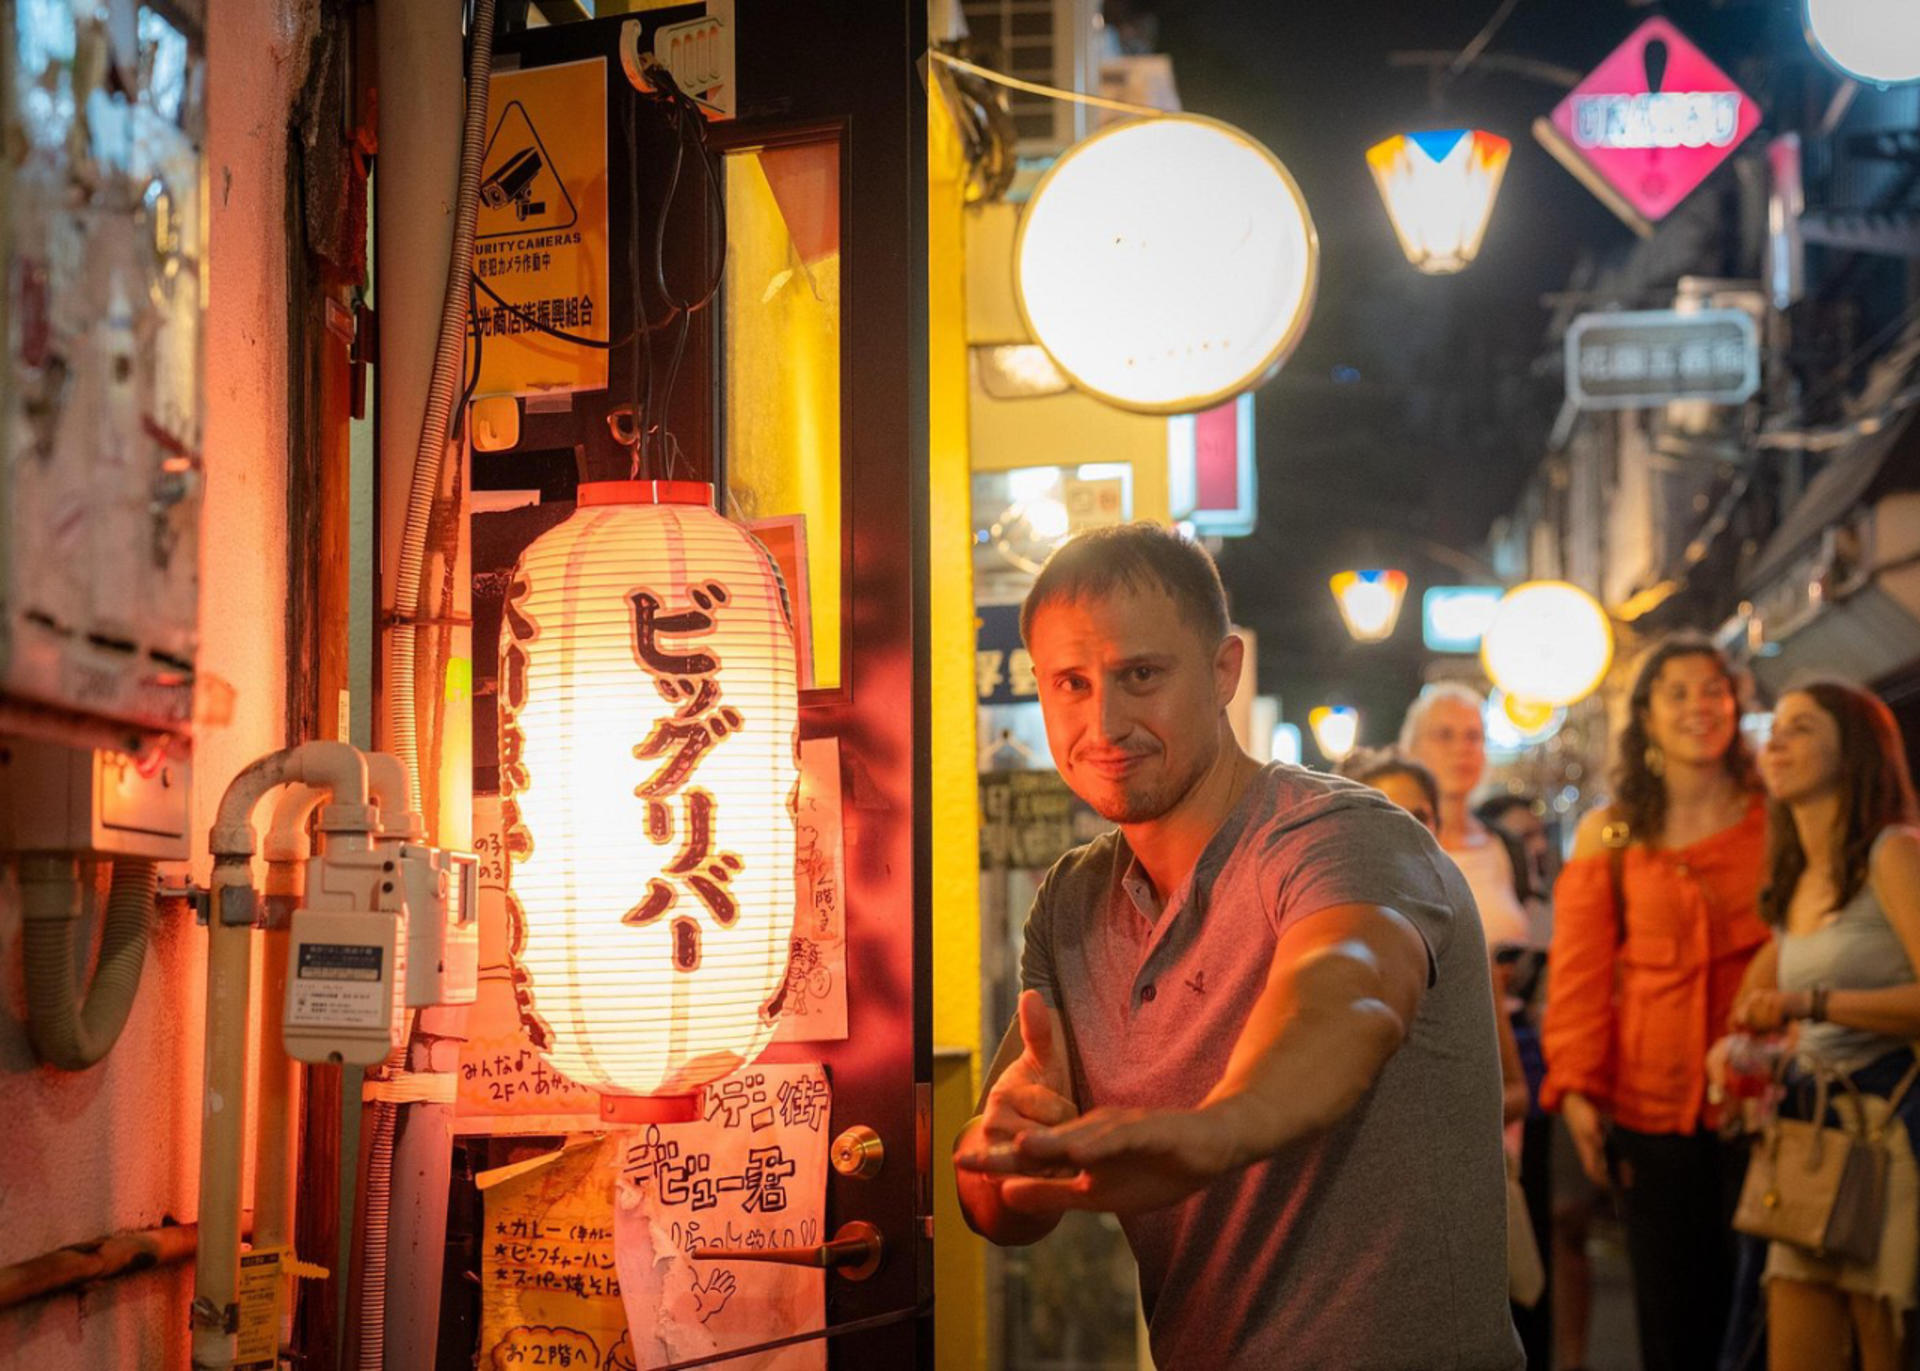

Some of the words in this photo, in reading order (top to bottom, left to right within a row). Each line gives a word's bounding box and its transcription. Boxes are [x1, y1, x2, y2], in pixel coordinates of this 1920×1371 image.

[475, 241, 516, 255] URITY
[517, 232, 582, 250] CAMERAS
[478, 251, 551, 277] 防犯カメラ作動中
[622, 582, 743, 971] ビッグリバー
[462, 1055, 512, 1080] みんな
[511, 1219, 560, 1239] カレー
[504, 1343, 588, 1367] お2階へ
